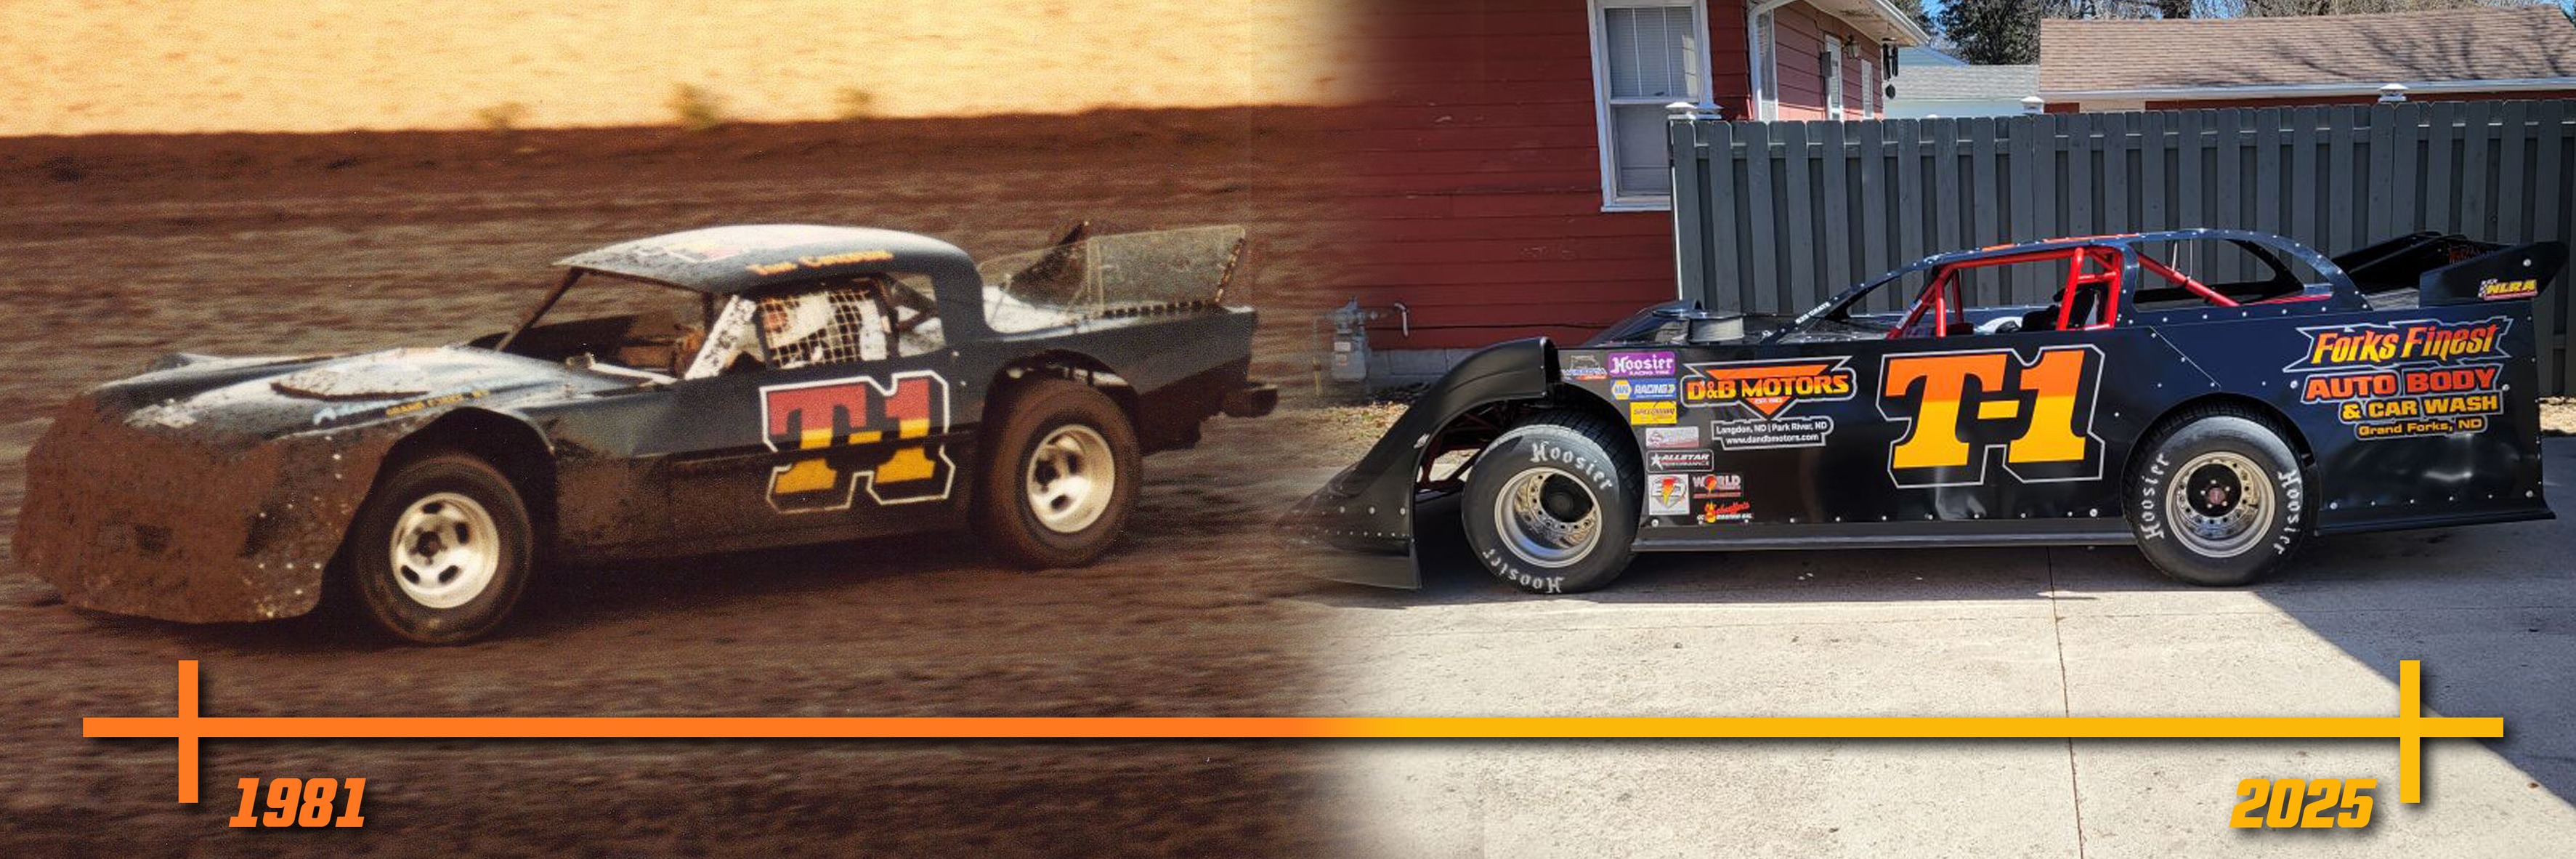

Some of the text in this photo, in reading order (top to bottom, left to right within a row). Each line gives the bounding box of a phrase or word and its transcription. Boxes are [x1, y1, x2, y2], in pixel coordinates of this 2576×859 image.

[2311, 324, 2500, 364] Forks Finest
[1609, 354, 1673, 376] Hoosier
[1687, 374, 1850, 400] D&B MOTORS
[2305, 368, 2496, 400] AUTO BODY
[1884, 349, 2086, 470] T-1
[2342, 395, 2498, 420] & CAR WASH
[763, 374, 939, 496] T-1
[1717, 425, 1753, 436] Langdon,
[1754, 424, 1767, 433] ND
[1772, 423, 1791, 432] Park
[1815, 421, 1828, 430] ND
[1726, 434, 1819, 445] www.dandbmotors.com
[2359, 418, 2483, 436] Grand Forks, ND
[1529, 440, 1613, 490] Hoosier
[2140, 453, 2170, 541] Hoosier
[2273, 469, 2303, 555] Hoosier
[1483, 549, 1565, 594] Hoosier
